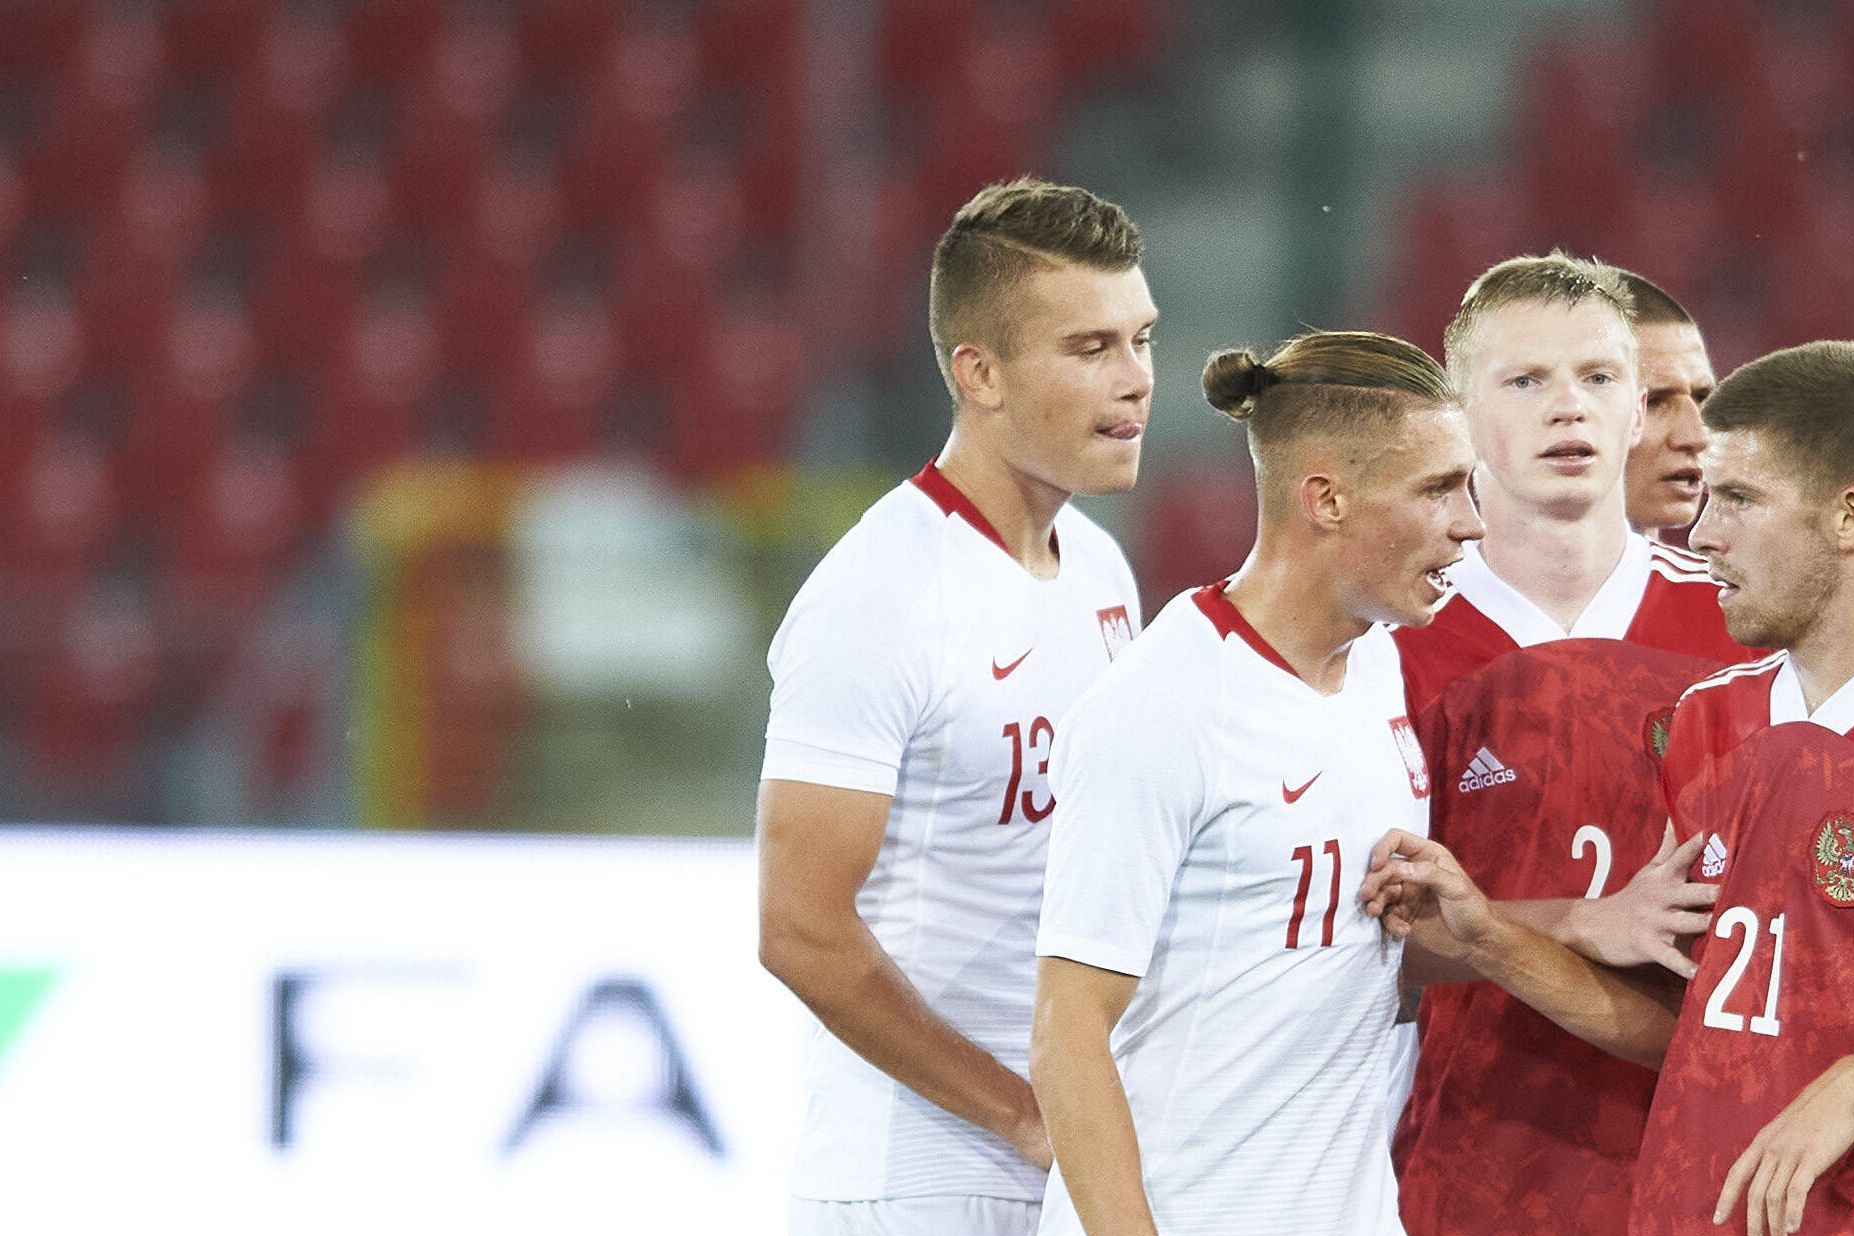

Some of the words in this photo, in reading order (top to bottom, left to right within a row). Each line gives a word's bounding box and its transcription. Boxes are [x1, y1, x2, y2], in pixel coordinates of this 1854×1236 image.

[998, 716, 1056, 824] 13
[1459, 769, 1516, 793] adidas
[1285, 839, 1342, 950] 11
[1571, 825, 1612, 899] 2
[1703, 906, 1786, 1036] 21
